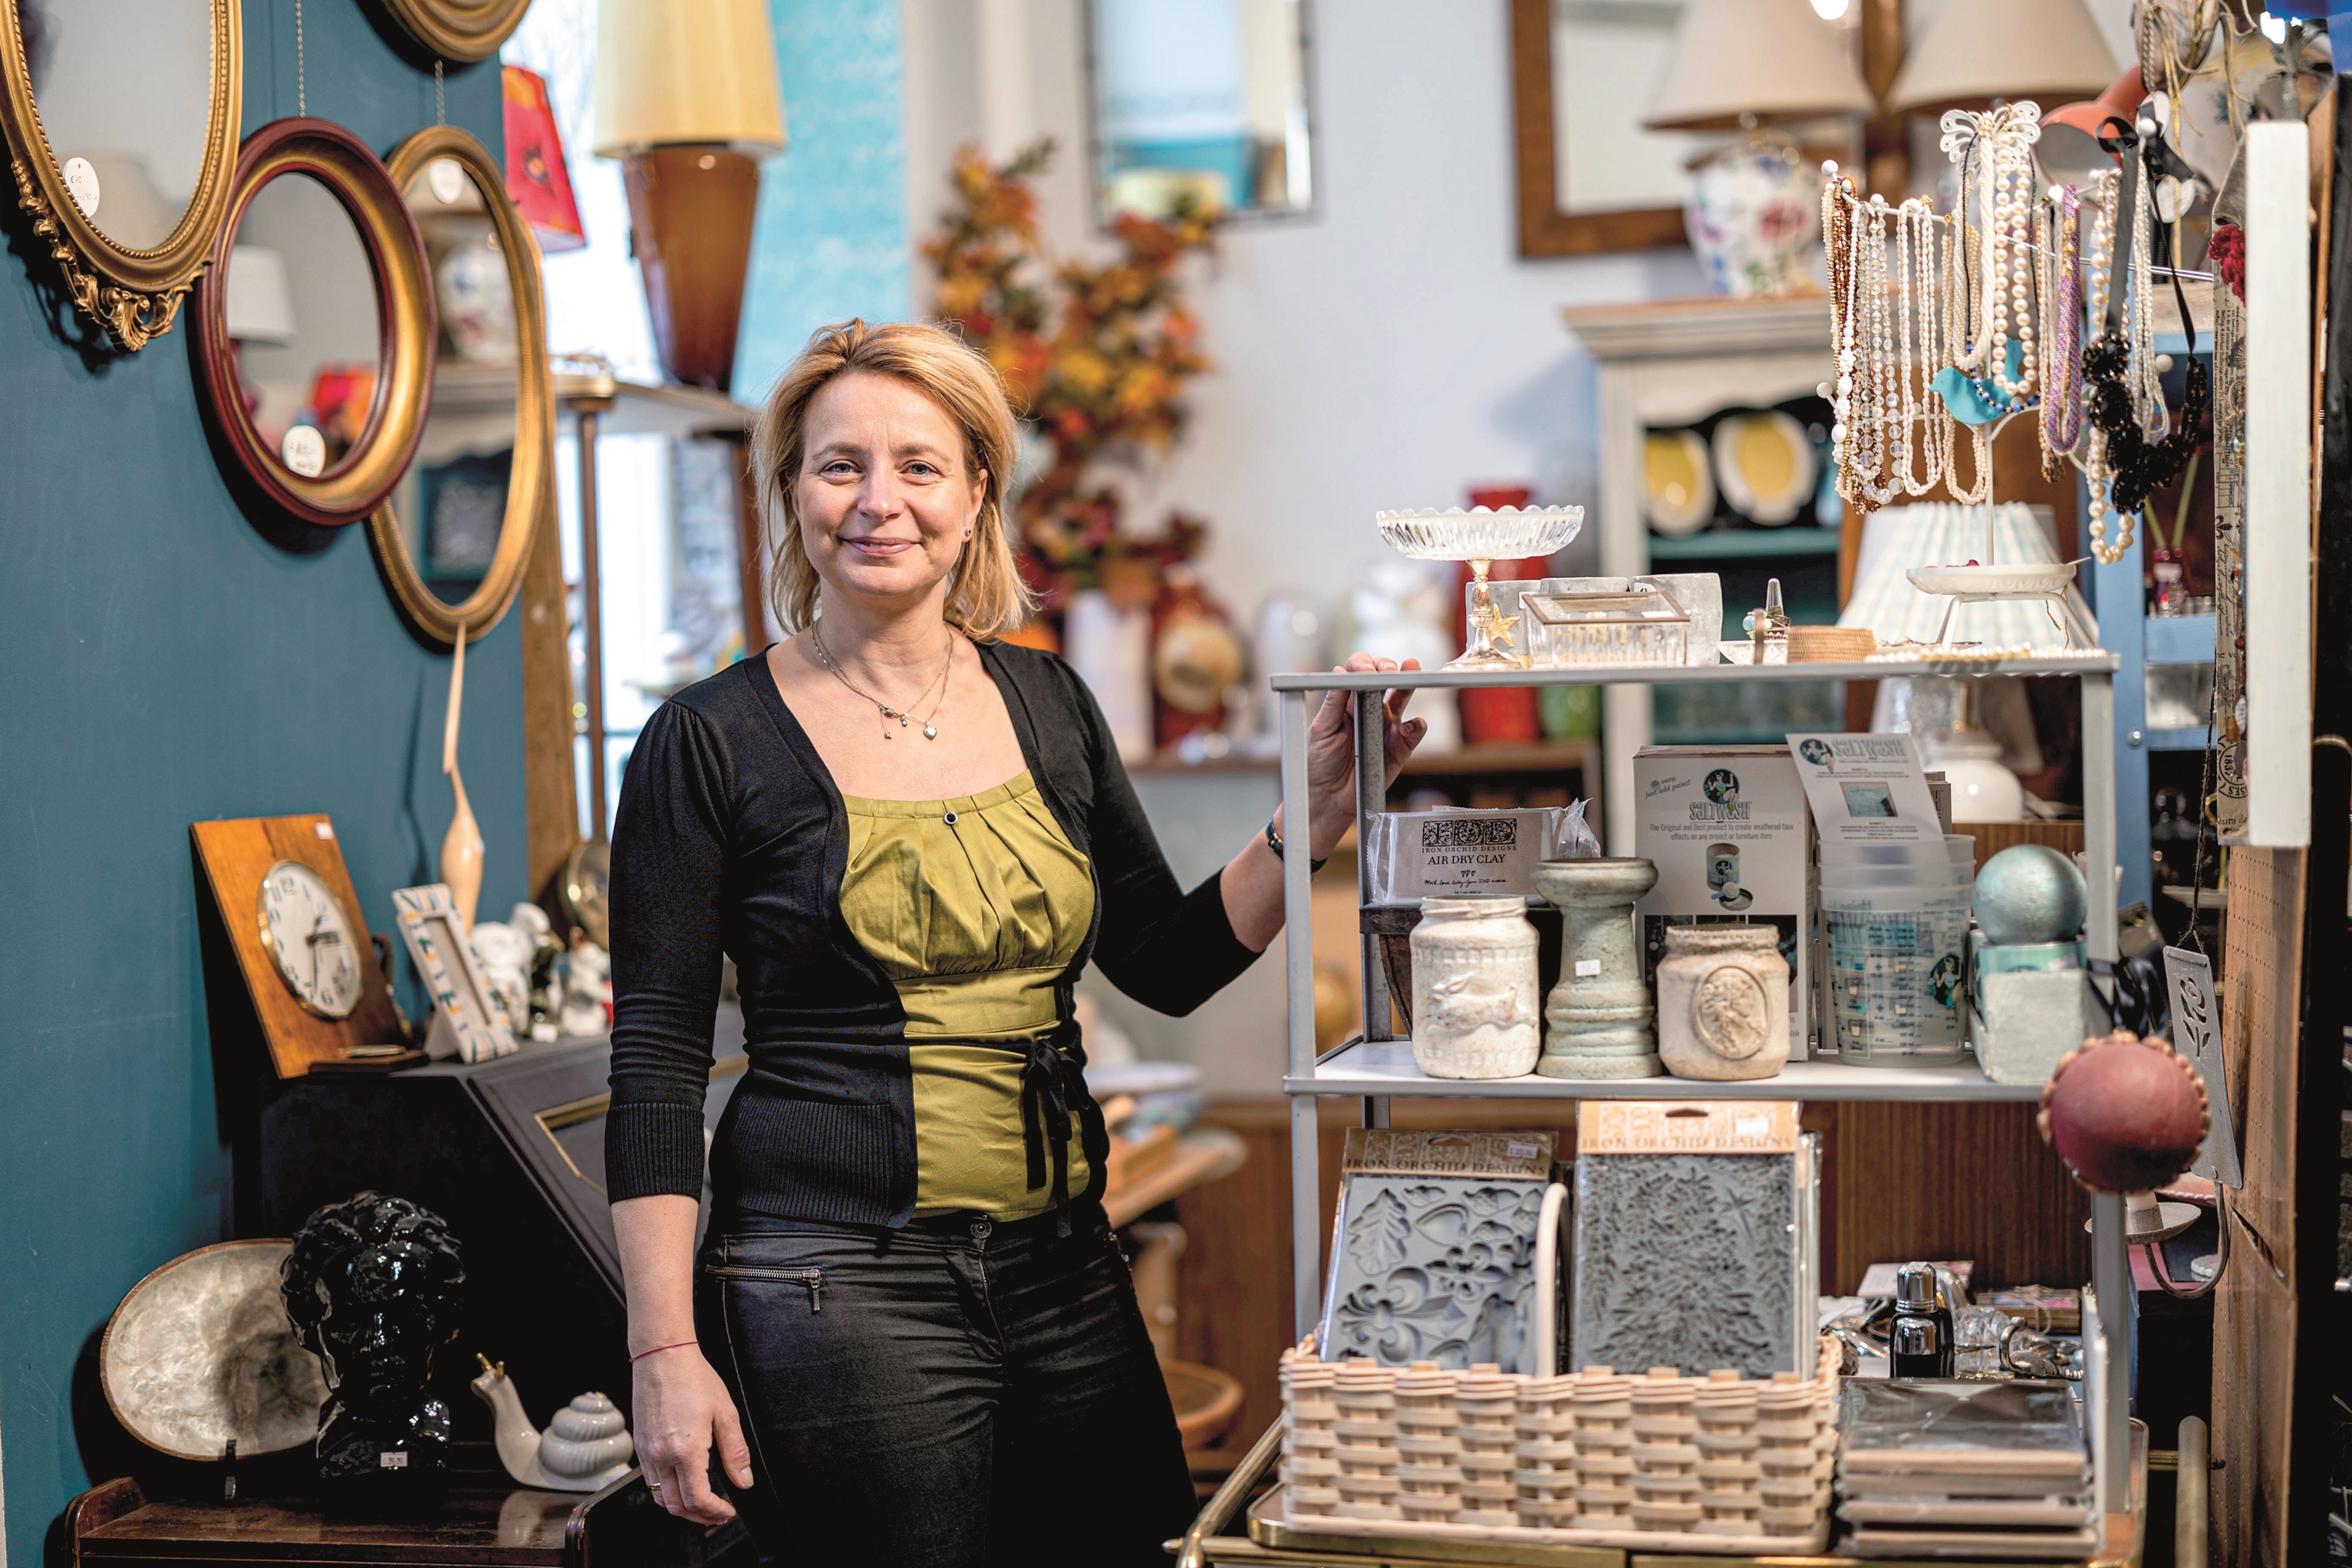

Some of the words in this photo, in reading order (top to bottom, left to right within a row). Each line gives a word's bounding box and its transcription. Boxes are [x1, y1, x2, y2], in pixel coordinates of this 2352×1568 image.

[1645, 789, 1658, 800] just
[1659, 784, 1671, 794] add
[1672, 779, 1691, 792] paint!
[1660, 823, 1682, 832] Original
[1706, 824, 1727, 832] product
[1428, 856, 1448, 865] AIR
[1451, 855, 1474, 865] DRY
[1476, 854, 1506, 864] CLAY
[1581, 1137, 1627, 1149] IRON
[1634, 1137, 1708, 1149] ORCHID
[1715, 1136, 1792, 1148] DESIGNS
[1346, 1158, 1389, 1168] IRON
[1396, 1159, 1465, 1171] ORCHID
[1472, 1162, 1546, 1175] DESIGNS
